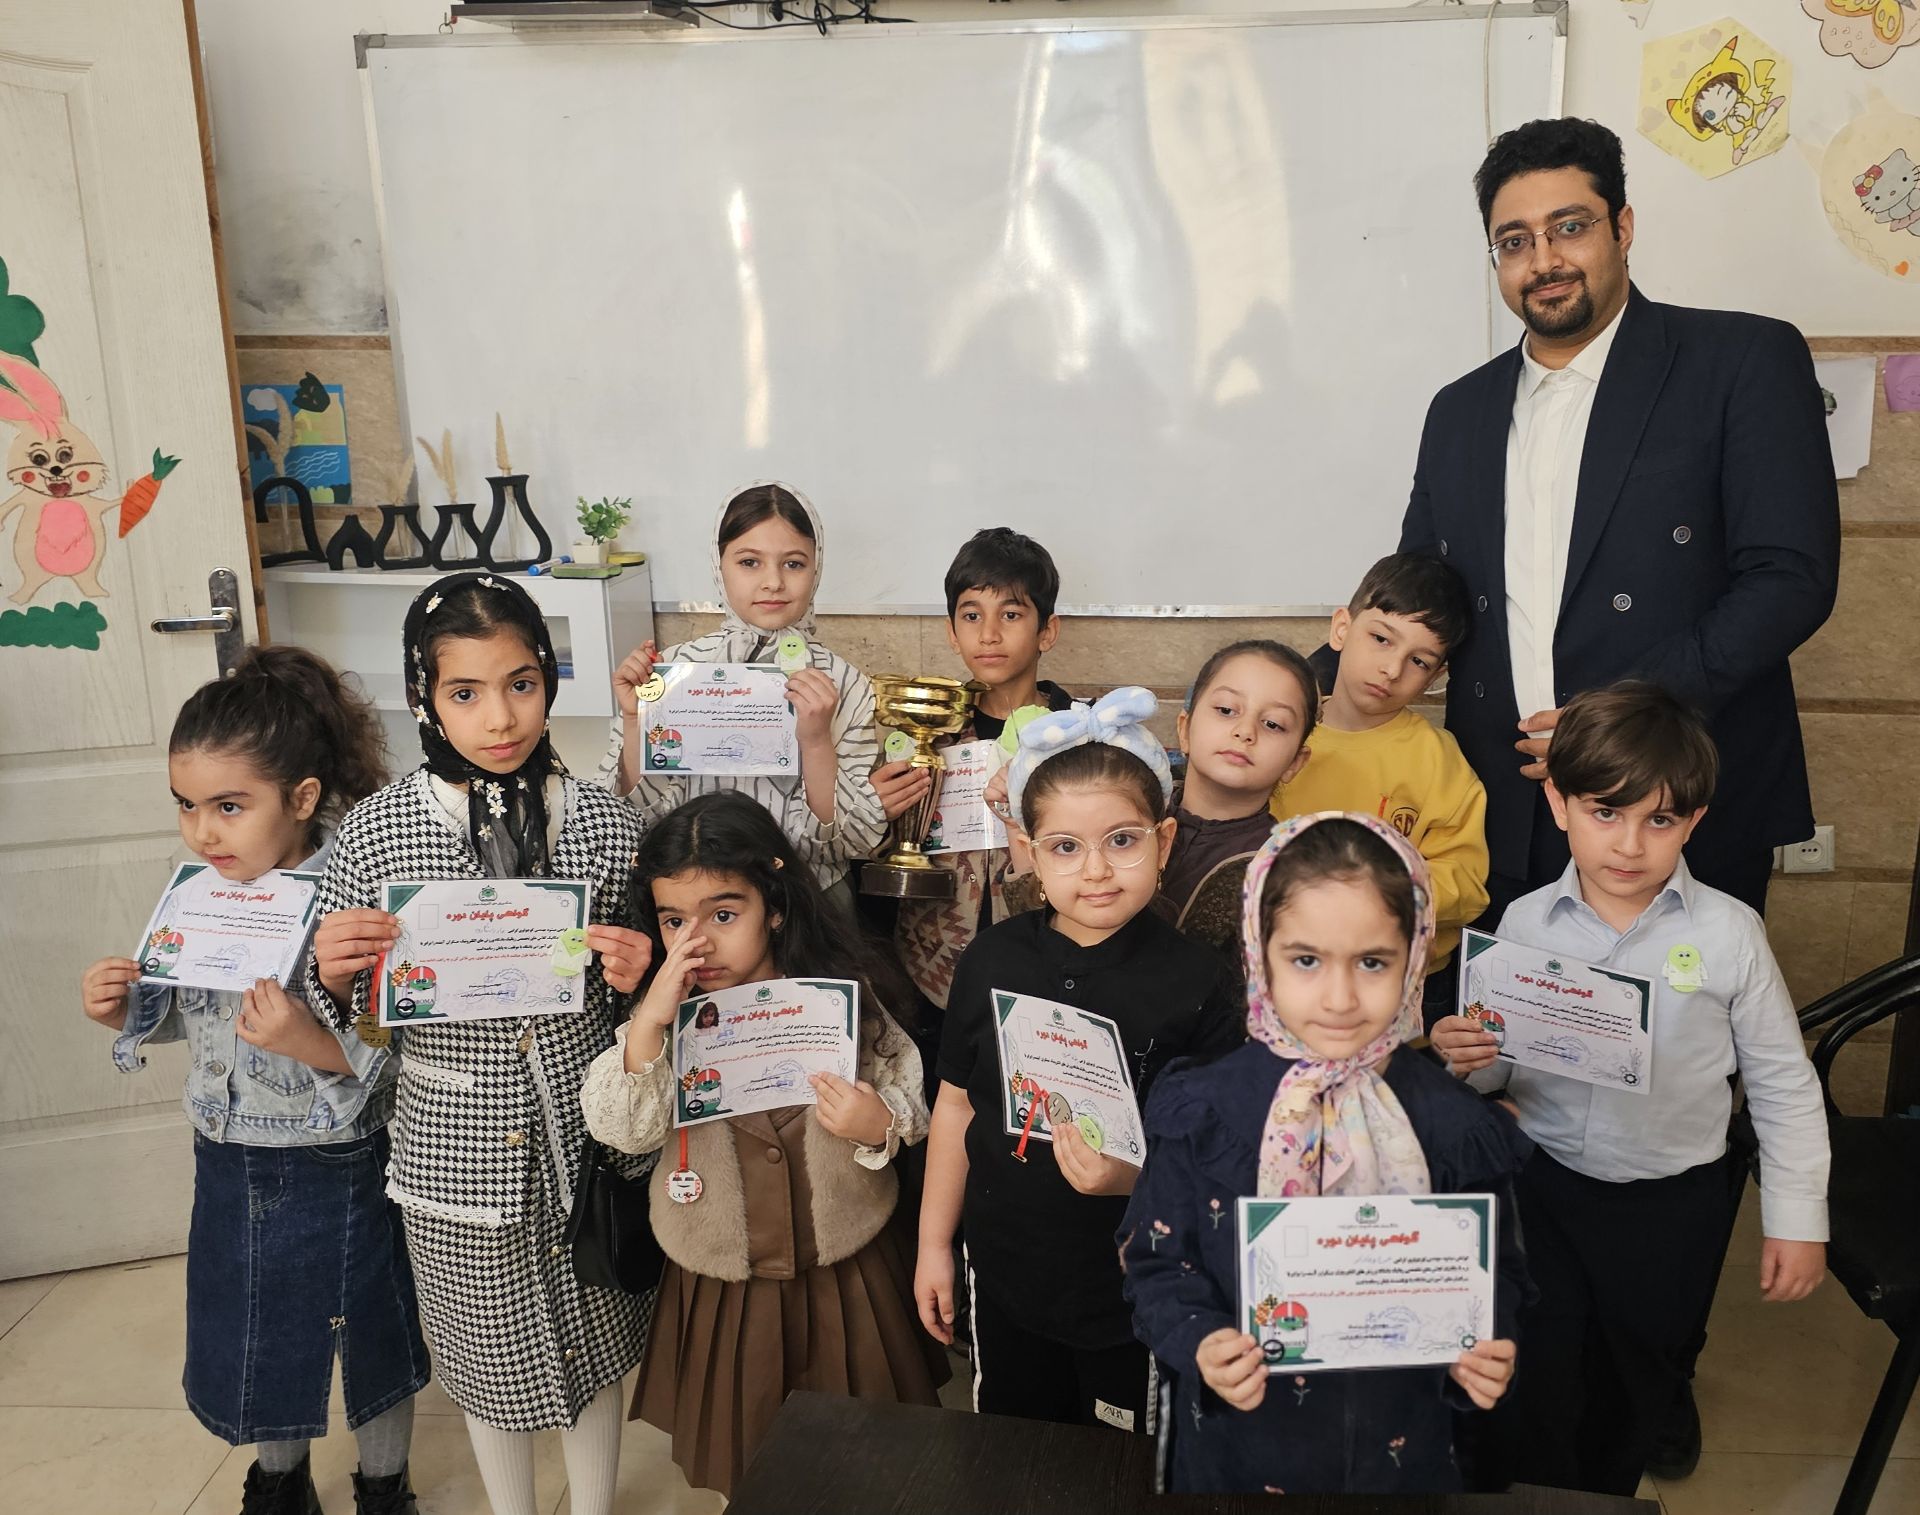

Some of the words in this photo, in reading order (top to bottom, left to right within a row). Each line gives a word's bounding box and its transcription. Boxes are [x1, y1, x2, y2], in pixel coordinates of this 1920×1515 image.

[446, 912, 467, 921] دوره
[469, 910, 495, 922] پایان
[496, 907, 529, 920] گواهی
[1514, 973, 1535, 984] دوره
[1535, 978, 1560, 994] پایان
[1561, 987, 1594, 998] گواهی
[747, 1008, 771, 1021] پایان
[772, 1004, 804, 1017] گواهی
[726, 1014, 746, 1025] دوره
[1316, 1236, 1342, 1249] دوره
[1345, 1234, 1376, 1249] پایان
[1379, 1230, 1420, 1246] گواهی
